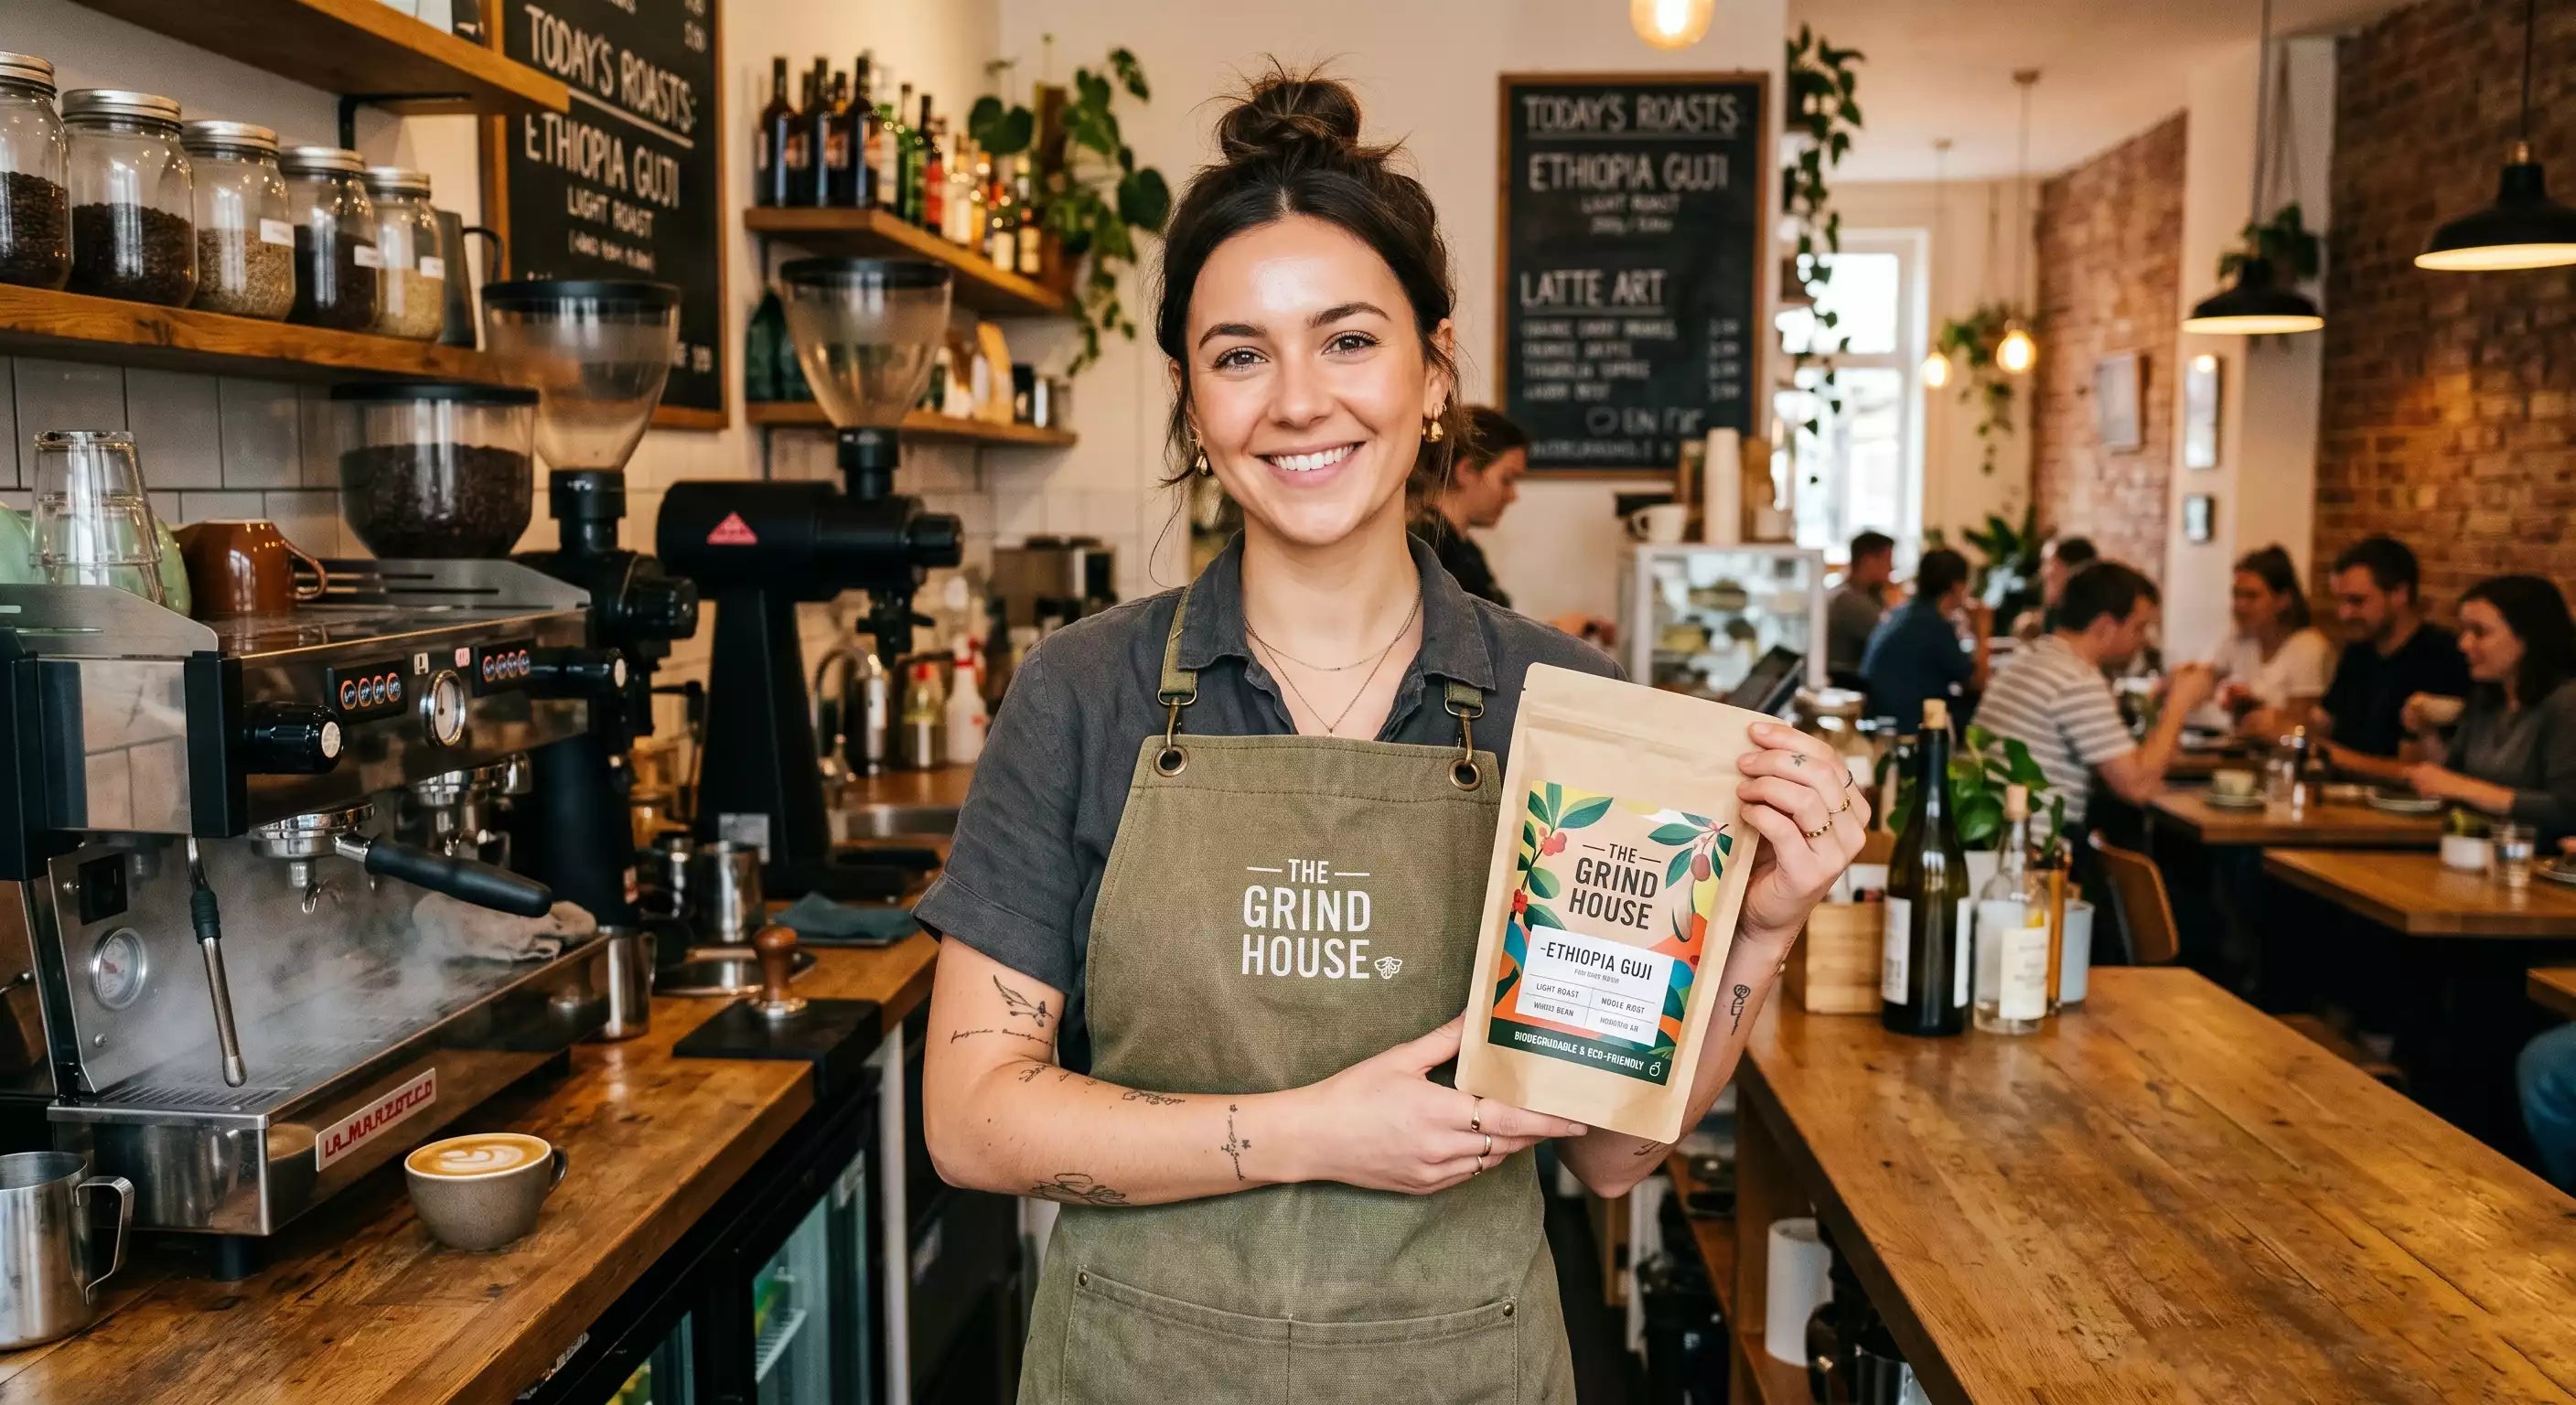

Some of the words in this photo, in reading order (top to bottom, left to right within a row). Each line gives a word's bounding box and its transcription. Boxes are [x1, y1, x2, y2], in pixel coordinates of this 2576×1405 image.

[524, 4, 615, 97] TODAY'S
[1522, 93, 1627, 134] TODAY'S
[524, 112, 628, 193] ETHIOPIA
[633, 144, 681, 210] GUJI
[1529, 152, 1656, 192] ETHIOPIA
[1662, 152, 1730, 192] GUJI
[1519, 270, 1603, 309] LATTE
[1611, 269, 1668, 306] ART
[1288, 858, 1329, 885] THE
[1609, 842, 1637, 864] THE
[1574, 856, 1658, 899] GRIND
[1243, 885, 1370, 932] GRIND
[1568, 887, 1653, 930] HOUSE
[1241, 934, 1370, 979] HOUSE
[1620, 958, 1653, 981] GUJI
[1536, 982, 1556, 993] LIGHT
[1557, 987, 1580, 999] ROAST
[1556, 1006, 1574, 1017] BEAN
[1579, 1046, 1586, 1056] &
[1587, 1047, 1645, 1072] ECO-FRIENDLY
